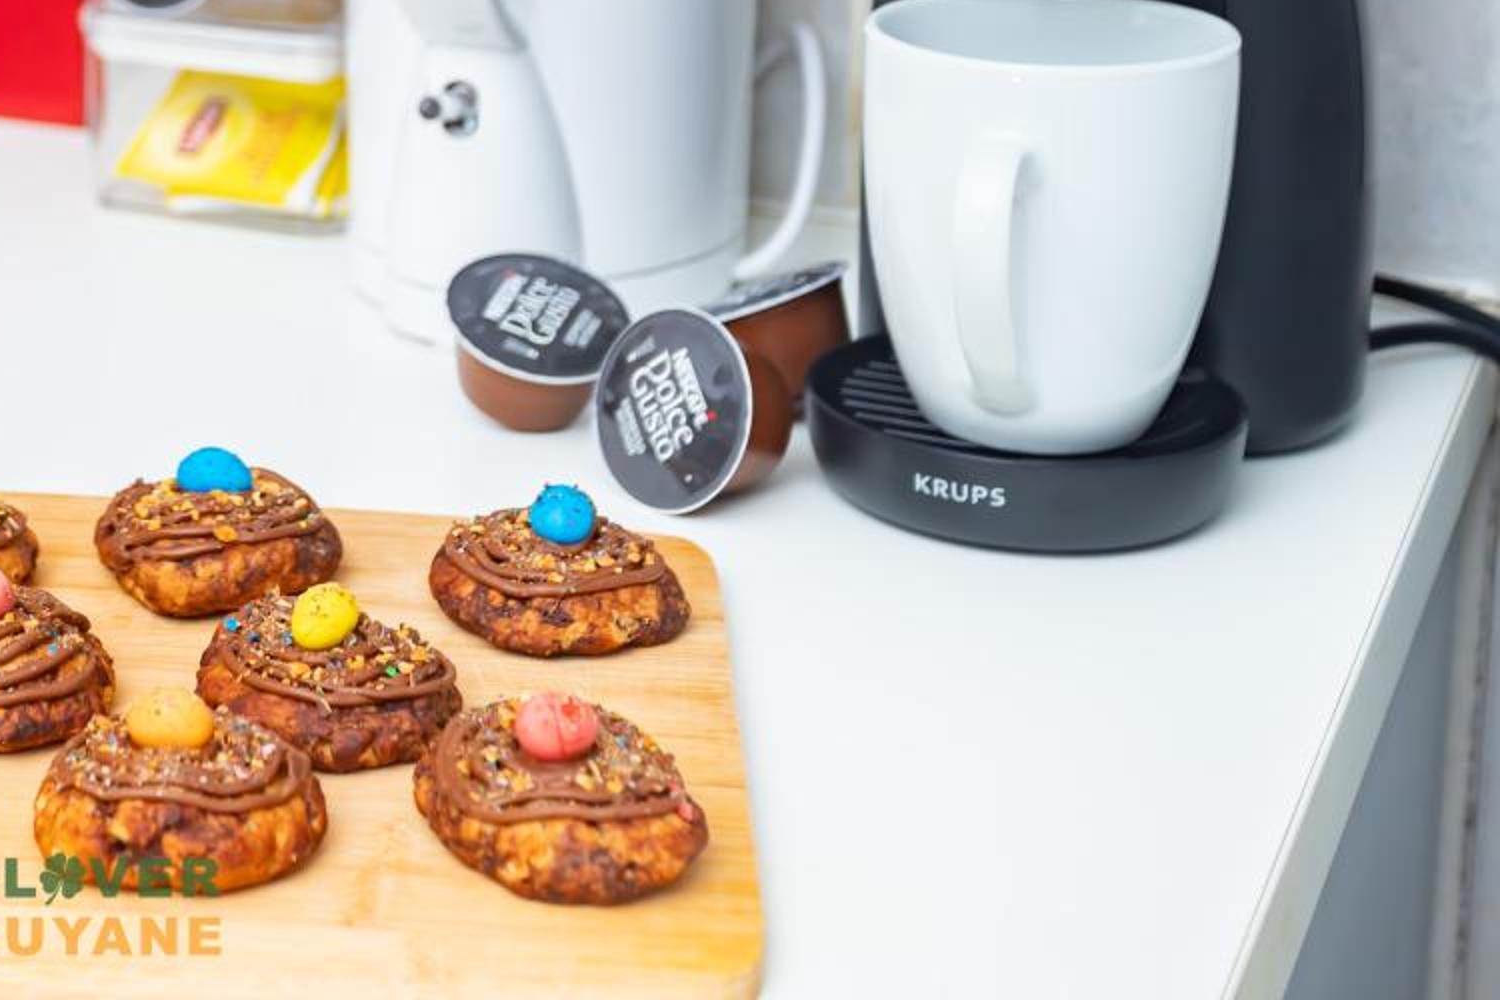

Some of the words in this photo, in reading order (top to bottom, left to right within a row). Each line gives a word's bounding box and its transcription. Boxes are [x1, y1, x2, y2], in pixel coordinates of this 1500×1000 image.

[630, 368, 675, 463] Gusto
[647, 348, 695, 449] Dolce
[914, 472, 1006, 508] KRUPS
